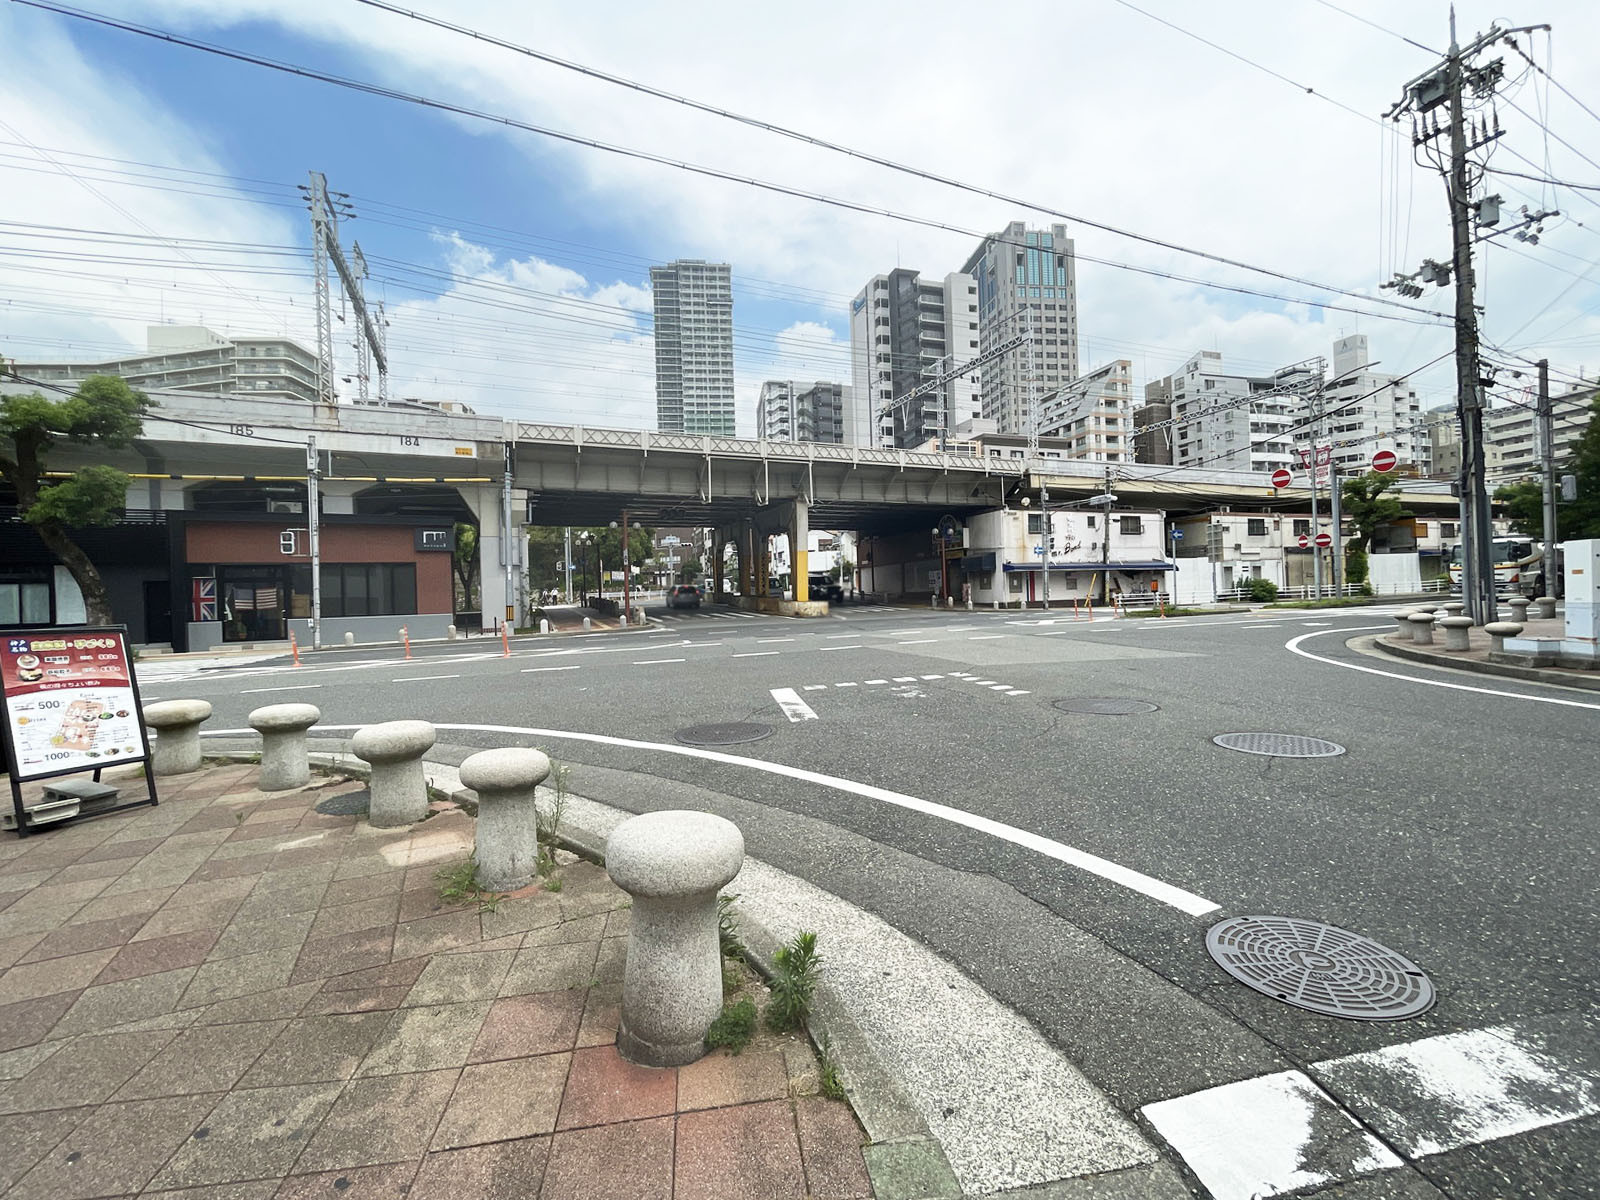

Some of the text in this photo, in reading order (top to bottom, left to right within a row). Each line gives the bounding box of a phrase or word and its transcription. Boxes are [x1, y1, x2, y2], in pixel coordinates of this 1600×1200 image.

[229, 425, 254, 436] 185
[400, 436, 420, 447] 184
[38, 700, 60, 710] 500
[45, 751, 70, 761] 1000
